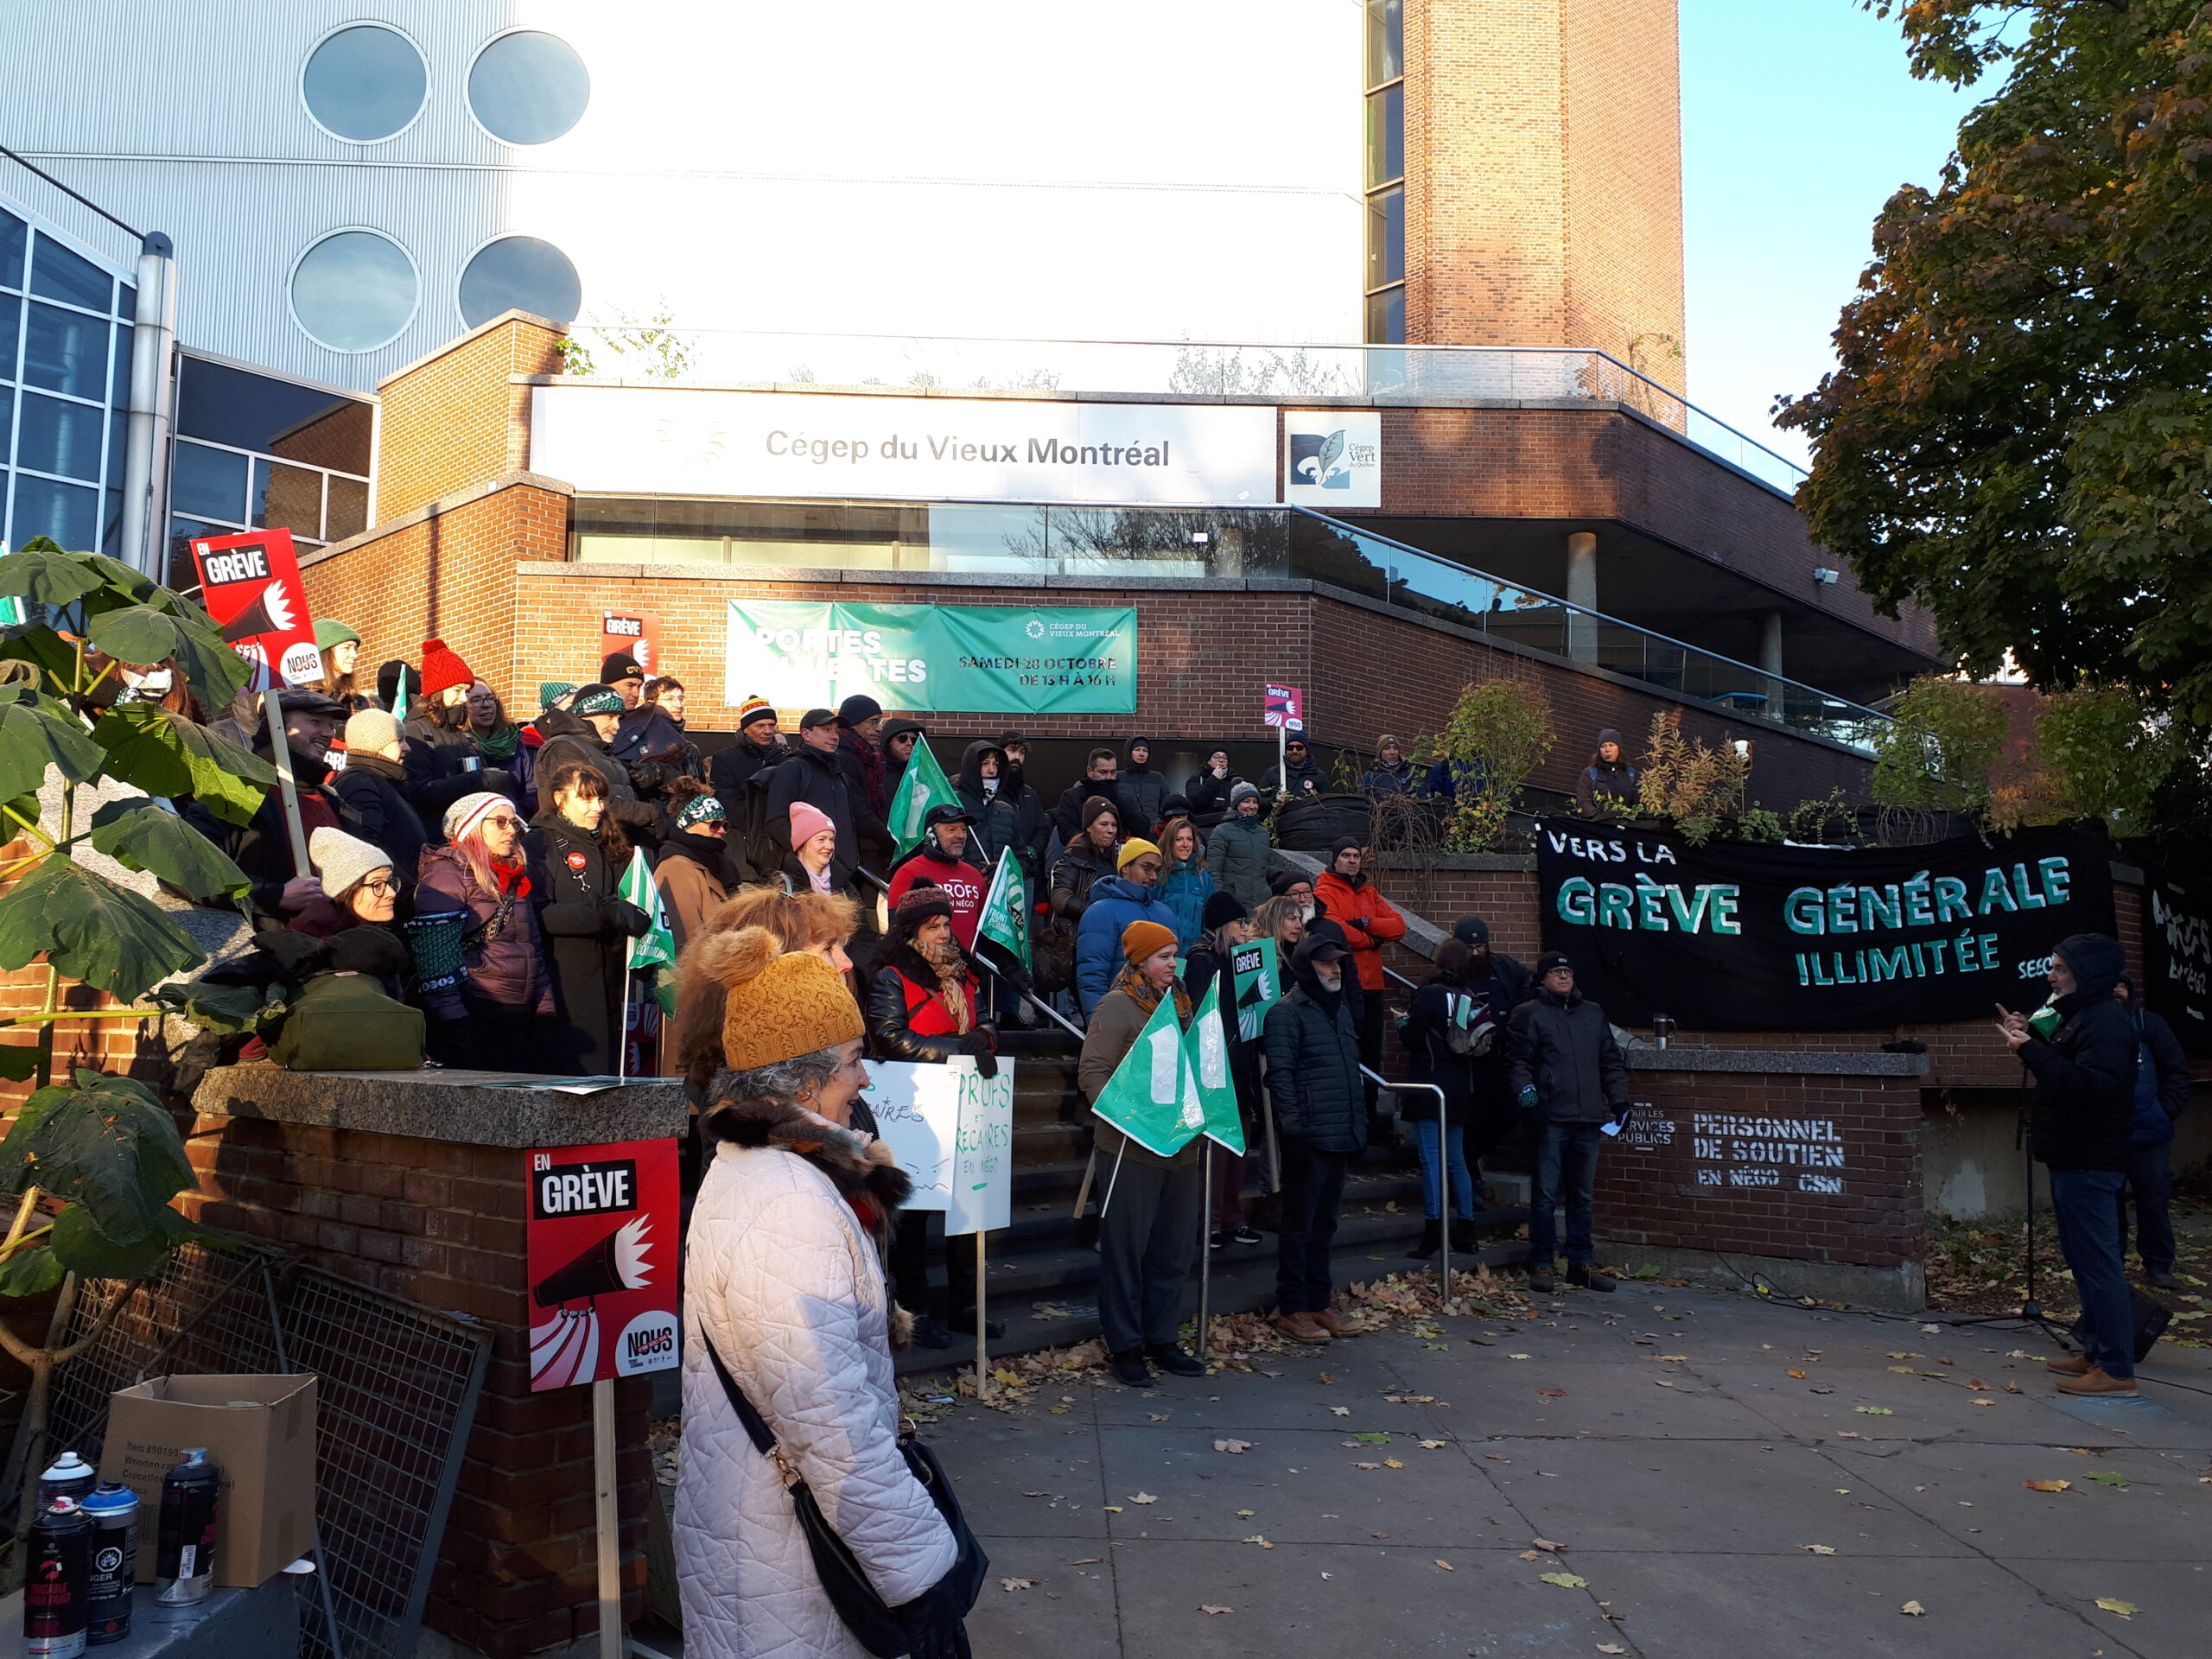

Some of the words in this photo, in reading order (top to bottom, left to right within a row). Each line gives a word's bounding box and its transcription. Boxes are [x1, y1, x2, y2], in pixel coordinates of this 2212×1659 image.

[766, 430, 869, 465] Cégep
[880, 434, 918, 460] du
[927, 435, 1019, 463] Vieux
[1027, 437, 1170, 467] Montréal
[1349, 442, 1375, 453] Cégep
[1349, 451, 1376, 462] Vert
[196, 542, 211, 556] EN
[206, 548, 267, 584] GRÈVE
[606, 617, 641, 636] GRÈVE
[754, 626, 883, 656] PORTES
[287, 652, 318, 674] NOUS
[958, 656, 1020, 669] SAMEDI
[1022, 658, 1039, 670] 28
[1044, 657, 1117, 670] OCTOBRE
[1019, 674, 1039, 685] DE
[1041, 674, 1055, 686] 13
[1059, 674, 1070, 685] H
[1073, 671, 1084, 685] À
[1087, 674, 1101, 686] 16
[1106, 674, 1116, 685] H
[1268, 688, 1290, 699] GRÈVE
[1547, 830, 1627, 862] VERS
[1637, 841, 1677, 865] LA
[956, 899, 975, 908] NÉGO
[1556, 872, 1742, 936] GRÈVE
[1783, 855, 2070, 936] GÉNÉRALE
[1236, 951, 1261, 973] GRÈVE
[1796, 927, 2000, 986] ILLIMITÉE
[974, 1114, 985, 1122] ET
[1648, 1109, 1664, 1119] LES
[1693, 1113, 1842, 1142] PERSONNEL
[1618, 1133, 1672, 1145] PUBLICS
[1694, 1138, 1723, 1160] DE
[1732, 1140, 1846, 1167] SOUTIEN
[534, 1154, 551, 1172] EN
[963, 1160, 975, 1174] EN
[1697, 1169, 1722, 1186] EN
[1729, 1165, 1780, 1186] NÉGO
[1797, 1173, 1843, 1194] CSN
[542, 1165, 630, 1214] GRÈVE
[627, 1326, 673, 1358] NOUS
[127, 1441, 145, 1452] Item
[146, 1445, 179, 1458] #90190
[124, 1456, 160, 1469] Wooden
